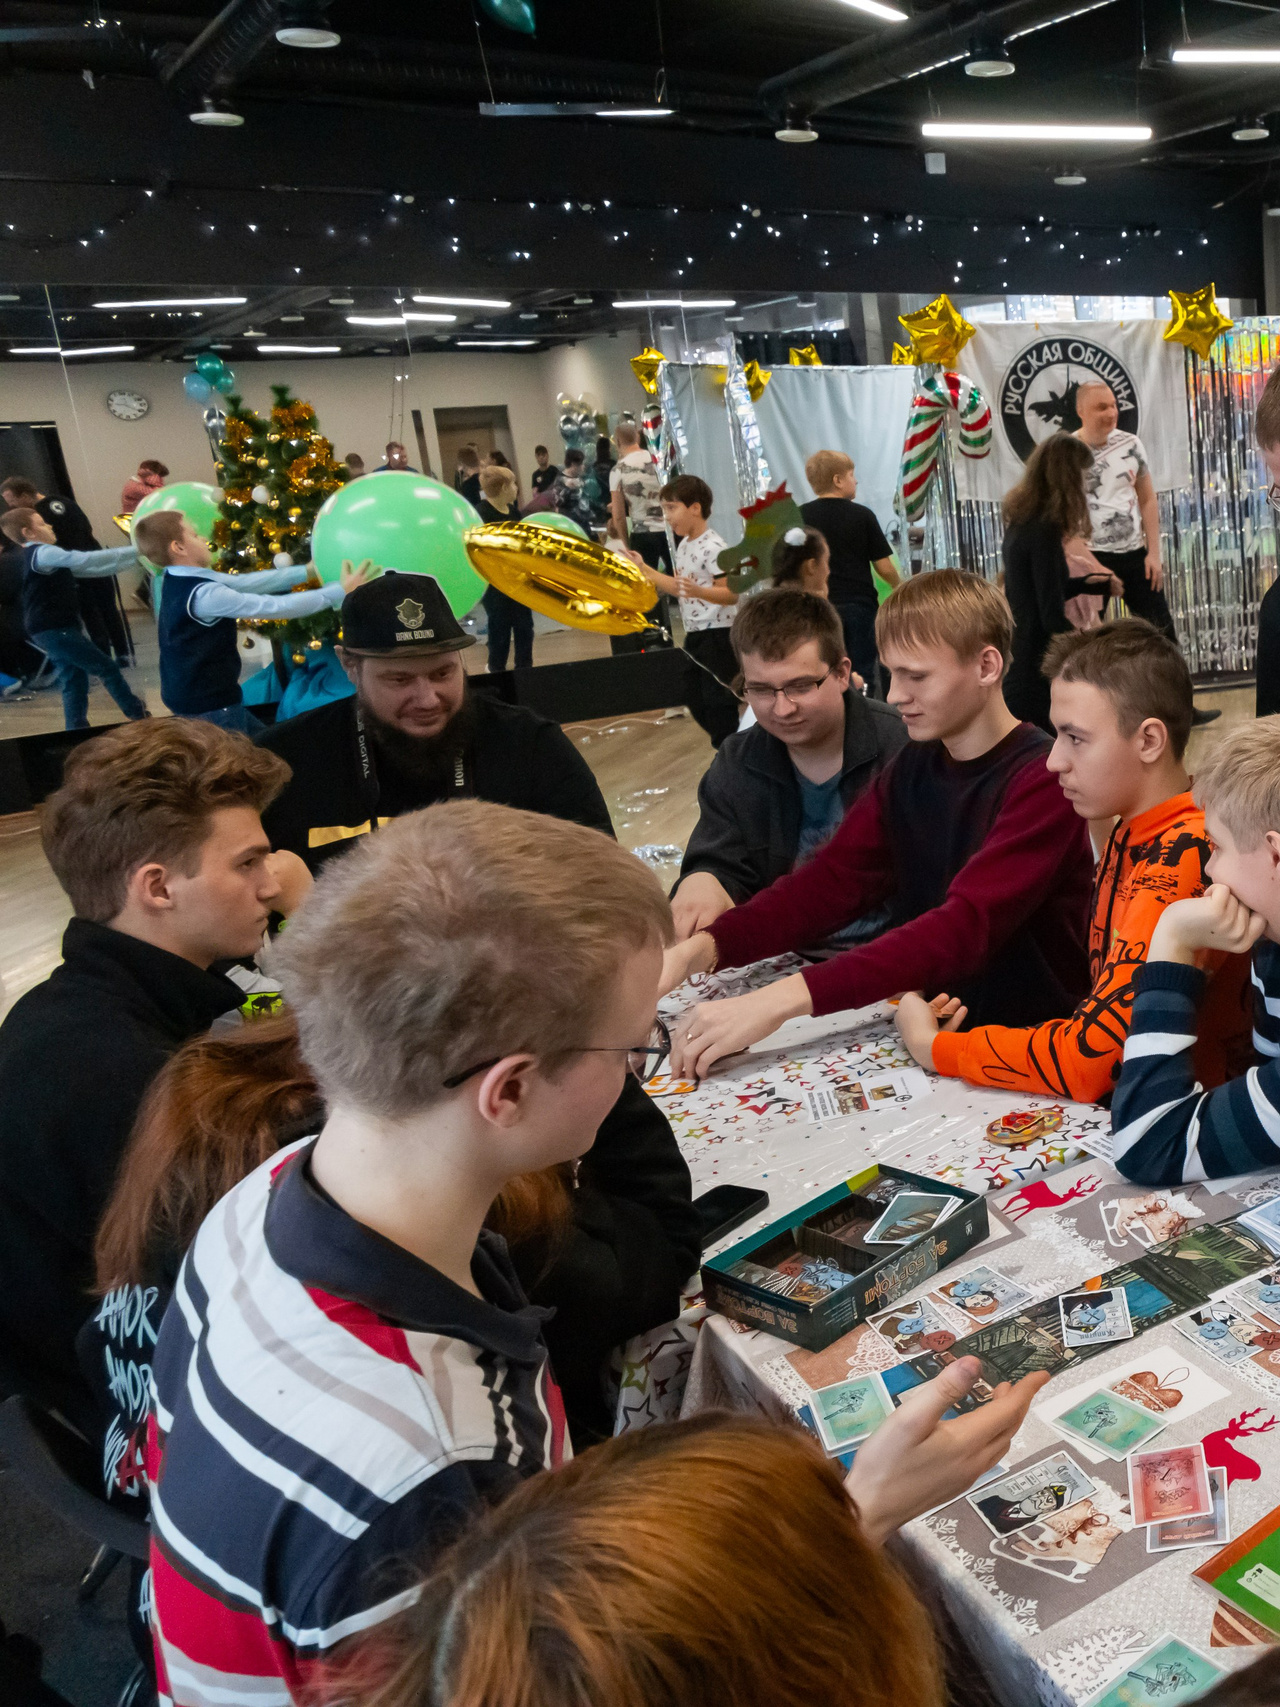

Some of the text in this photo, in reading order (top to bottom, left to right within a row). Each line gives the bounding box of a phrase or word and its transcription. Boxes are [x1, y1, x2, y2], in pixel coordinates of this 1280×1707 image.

[1004, 342, 1136, 415] РУССКАЯ ОБЩИНА
[395, 631, 413, 642] BANK
[358, 734, 370, 779] DIGITAL
[864, 1239, 948, 1305] ЗА БОРТОМ!
[93, 1282, 159, 1348] AMOR
